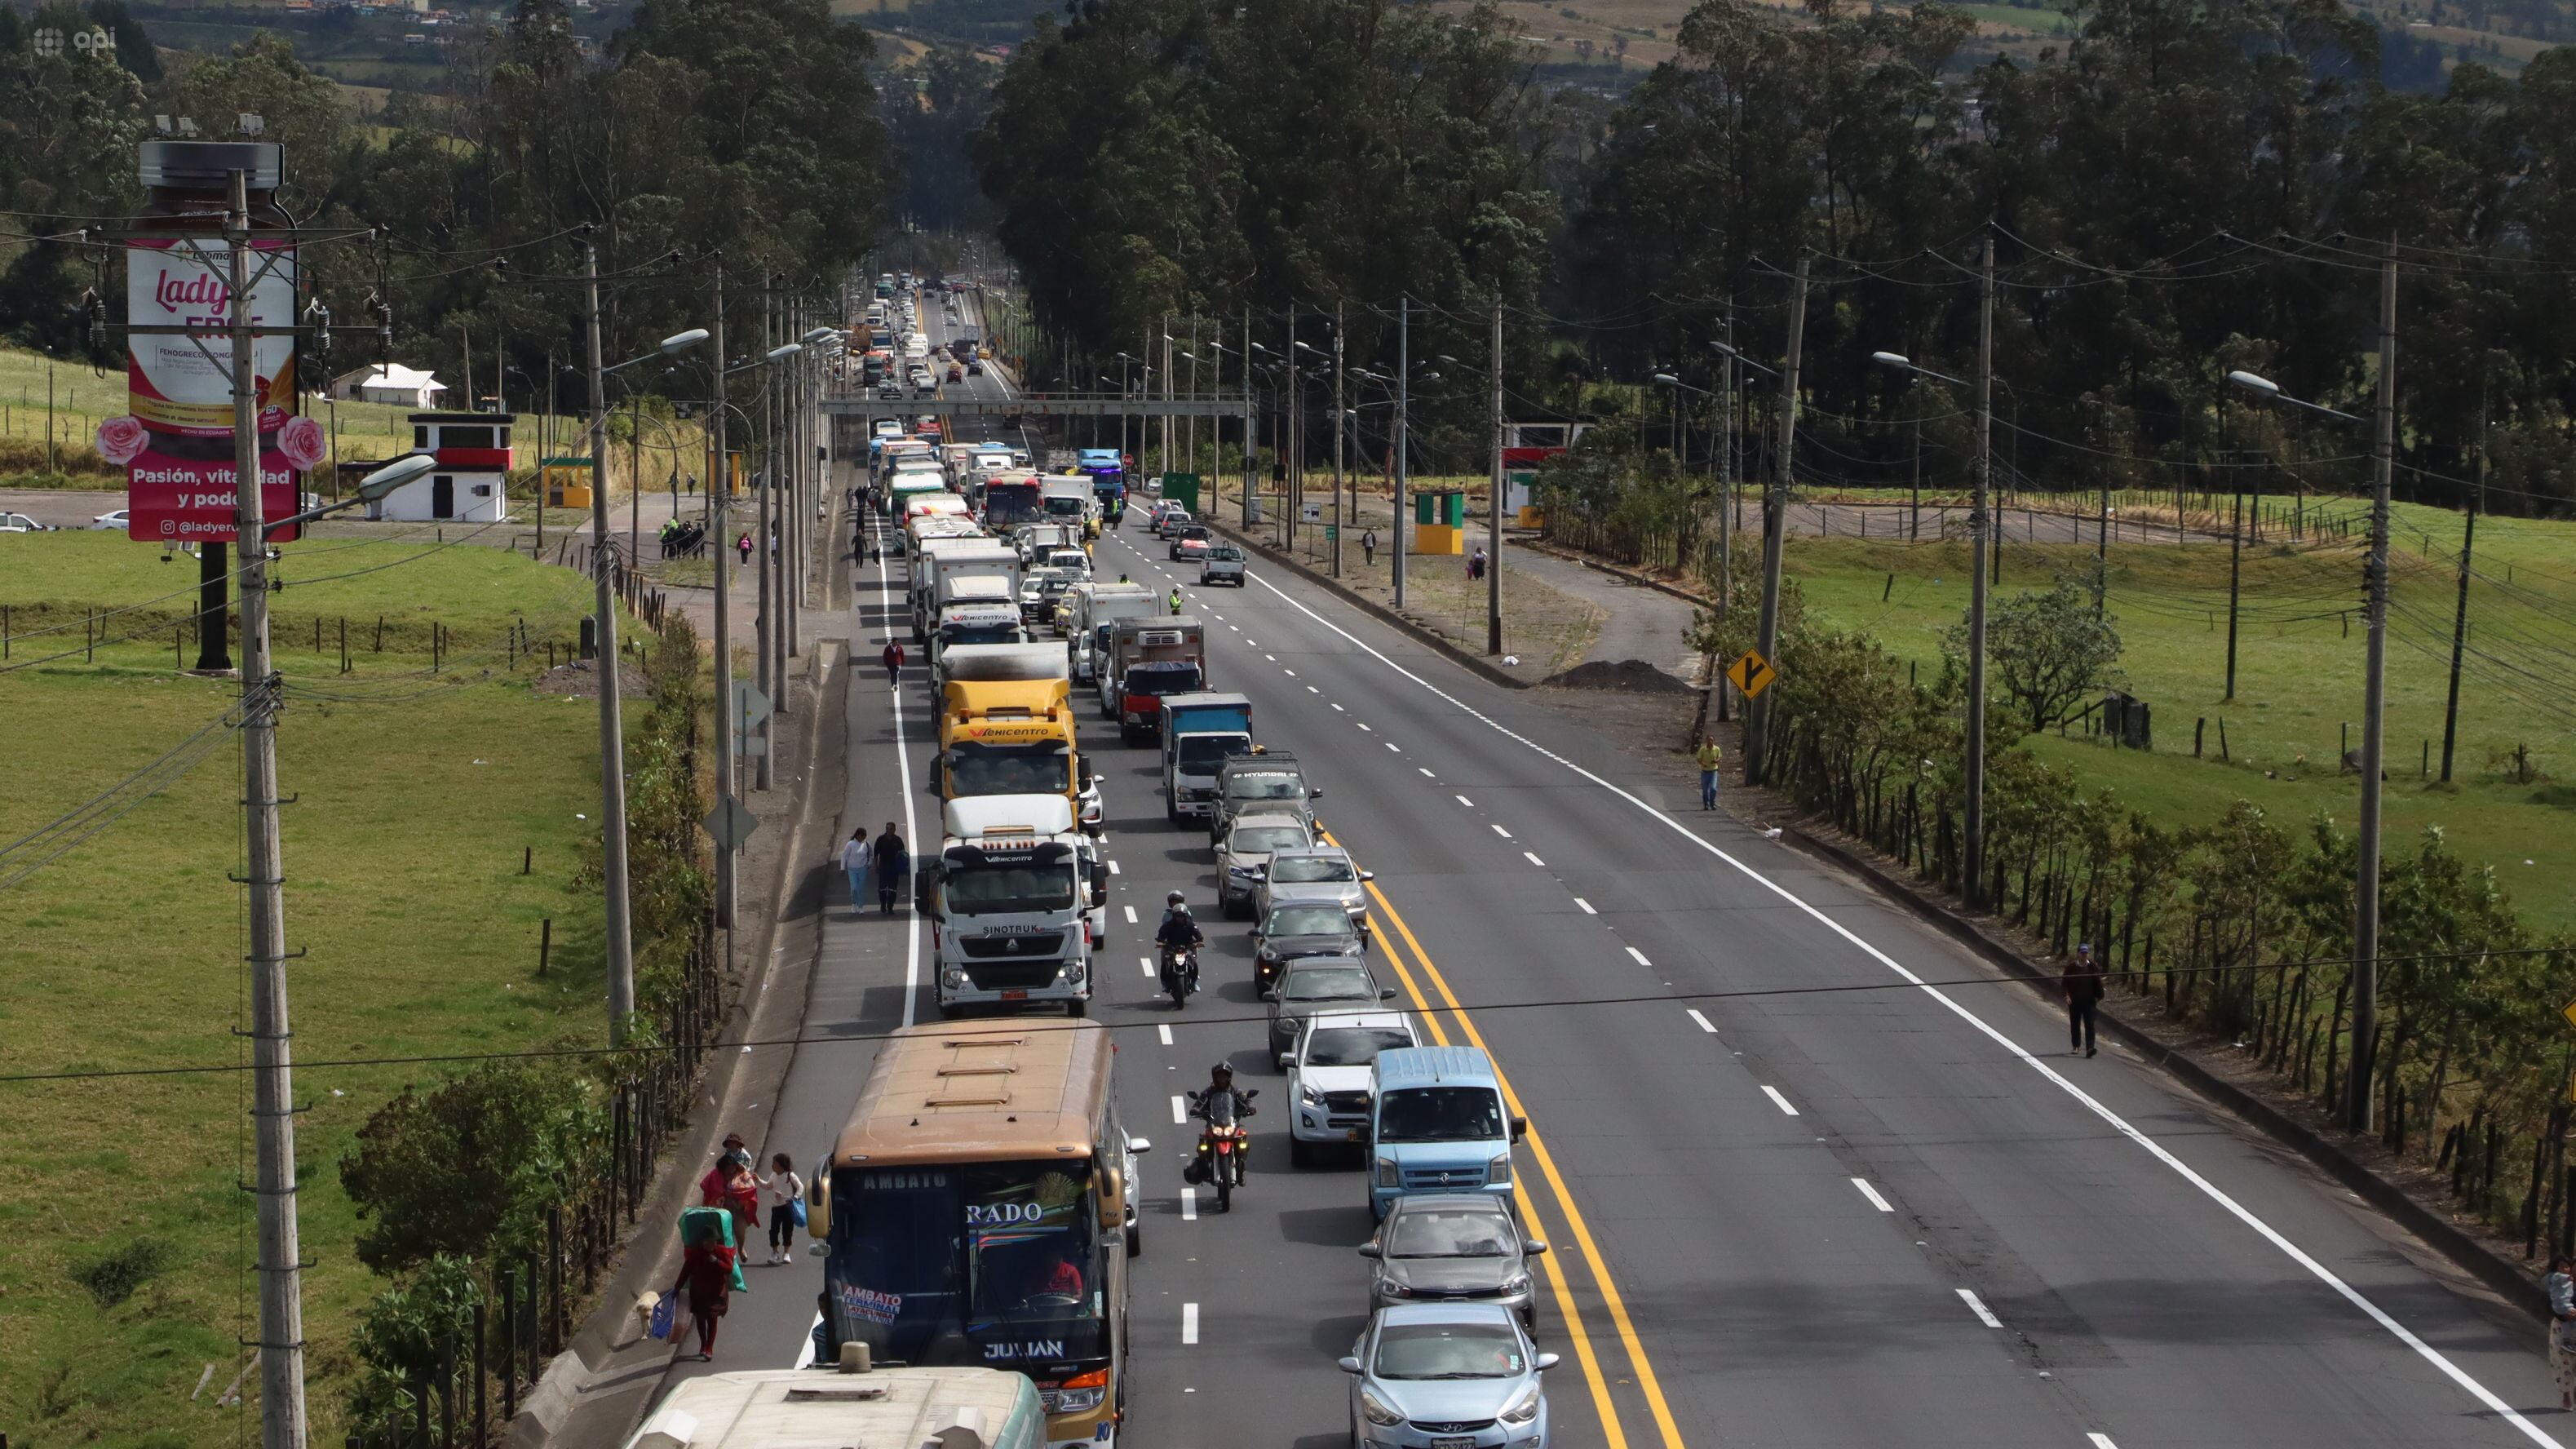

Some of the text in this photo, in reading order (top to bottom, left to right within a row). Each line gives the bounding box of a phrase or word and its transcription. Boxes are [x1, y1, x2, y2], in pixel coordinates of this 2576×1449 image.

[156, 269, 232, 315] Lady
[186, 316, 263, 339] ERS
[266, 404, 277, 414] 60
[133, 467, 290, 485] Pasión, vitadad
[178, 493, 189, 508] y
[983, 924, 1037, 934] SINOTRUK
[864, 1172, 947, 1190] AMBATO
[843, 1285, 901, 1306] AMBATO
[1095, 1421, 1110, 1442] 10
